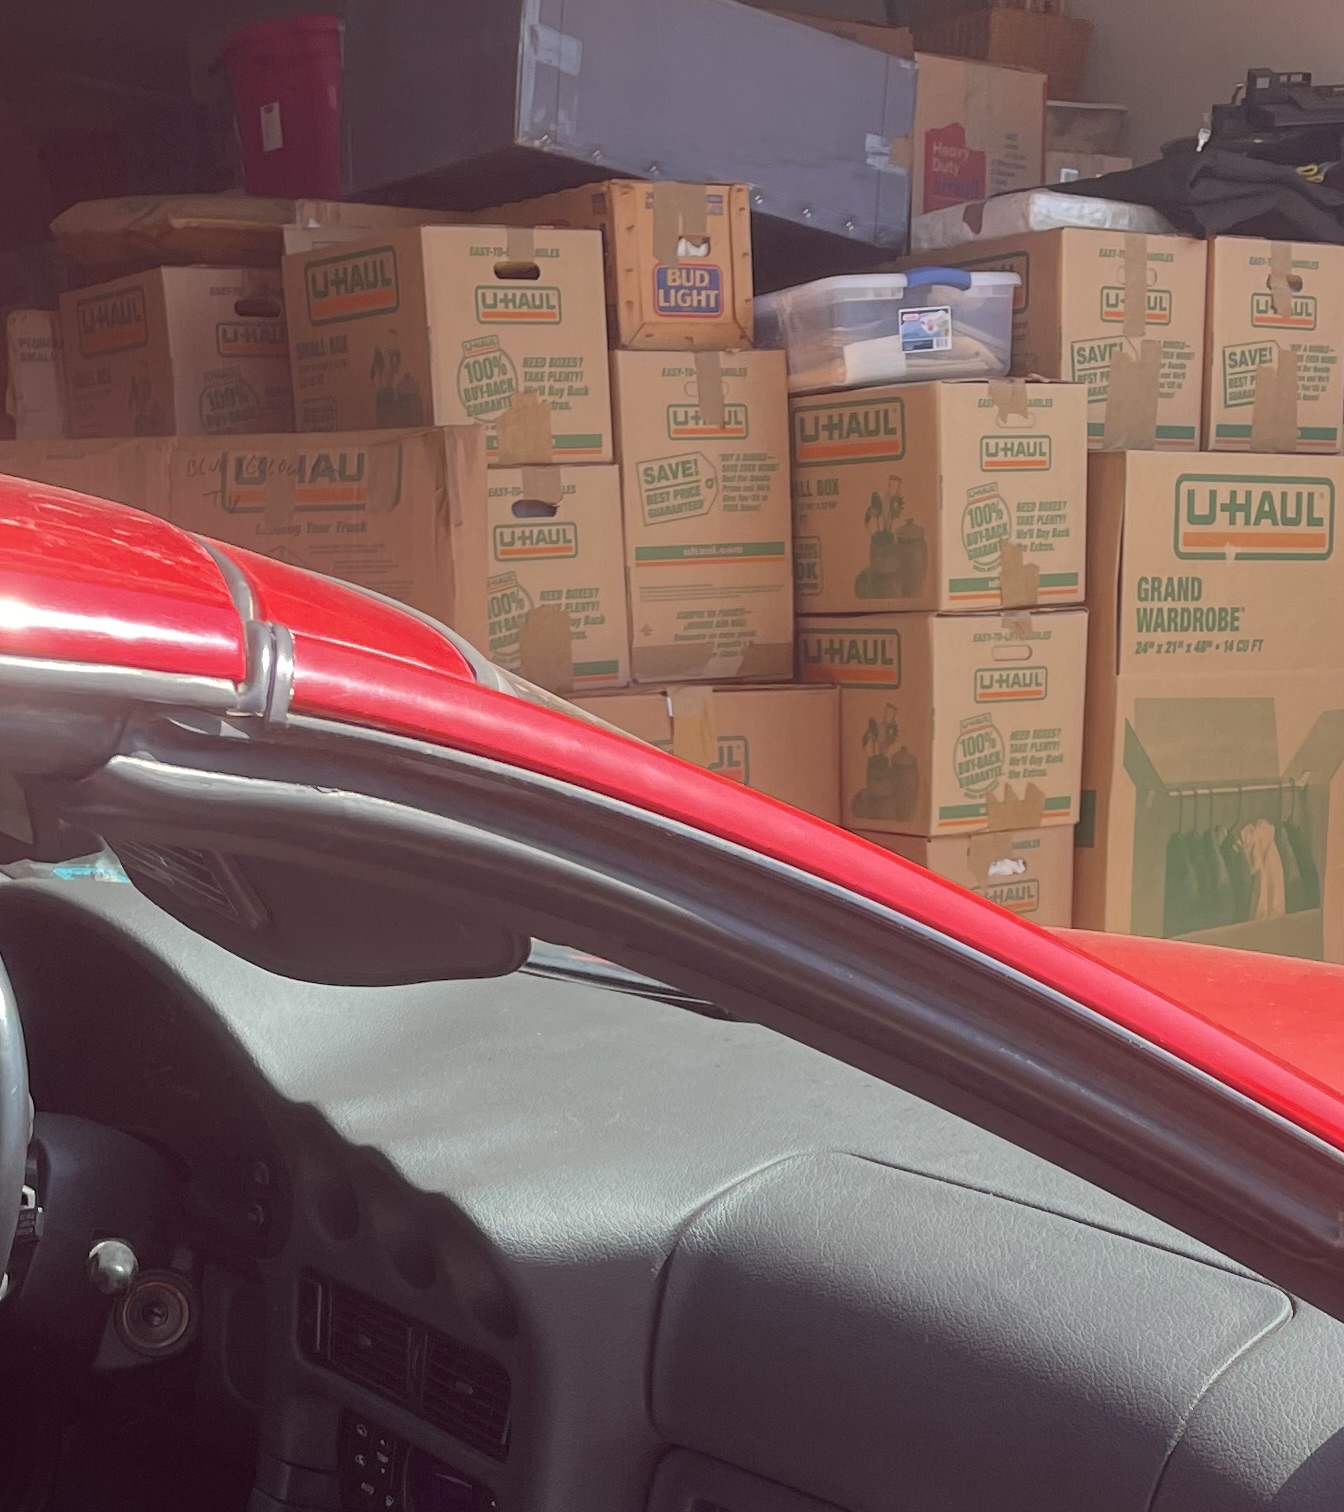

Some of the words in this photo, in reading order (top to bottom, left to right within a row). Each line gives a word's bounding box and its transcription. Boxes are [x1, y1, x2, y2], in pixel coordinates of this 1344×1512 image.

[932, 141, 970, 161] Heavy
[932, 158, 960, 176] Duty
[311, 258, 394, 300] U-HAUL
[667, 269, 710, 287] BUD
[481, 291, 557, 310] U-HAUL
[658, 288, 719, 308] LIGHT
[80, 299, 141, 334] U-HAUL
[522, 357, 547, 369] NEED
[549, 357, 585, 369] BOXES?
[1227, 346, 1273, 370] SAVE!
[463, 356, 508, 384] 100%
[524, 371, 546, 382] TAKE
[463, 379, 516, 402] BUY-BACK
[548, 385, 566, 398] Buy
[567, 385, 591, 397] Back
[799, 408, 898, 443] U-HAUL
[985, 440, 1047, 458] U-HAUL
[643, 458, 700, 486] SAVE!
[646, 489, 671, 506] BEST
[673, 485, 702, 502] PRICE
[816, 478, 840, 497] BOX
[647, 499, 705, 519] GUARANTEED
[968, 501, 1004, 530] 100%
[1016, 502, 1037, 513] NEED
[1186, 489, 1325, 527] U-HAUL
[306, 521, 335, 537] Your
[337, 520, 368, 534] Truck
[1016, 515, 1035, 526] TAKE
[500, 528, 573, 547] U-HAUL
[966, 523, 1009, 546] BUY-BACK
[683, 546, 744, 556] uhaul.com
[1136, 576, 1203, 603] GRAND
[1135, 607, 1241, 633] WARDROBE
[803, 639, 894, 666] U-HAUL
[1156, 643, 1163, 654] x
[1185, 643, 1193, 653] x
[1224, 639, 1235, 653] 14
[1236, 639, 1250, 652] CU
[1251, 639, 1264, 653] FT
[978, 671, 1044, 690] U-HAUL
[960, 731, 997, 759] 100%
[958, 751, 1002, 776] BUY-BACK
[991, 884, 1036, 904] HAUL
